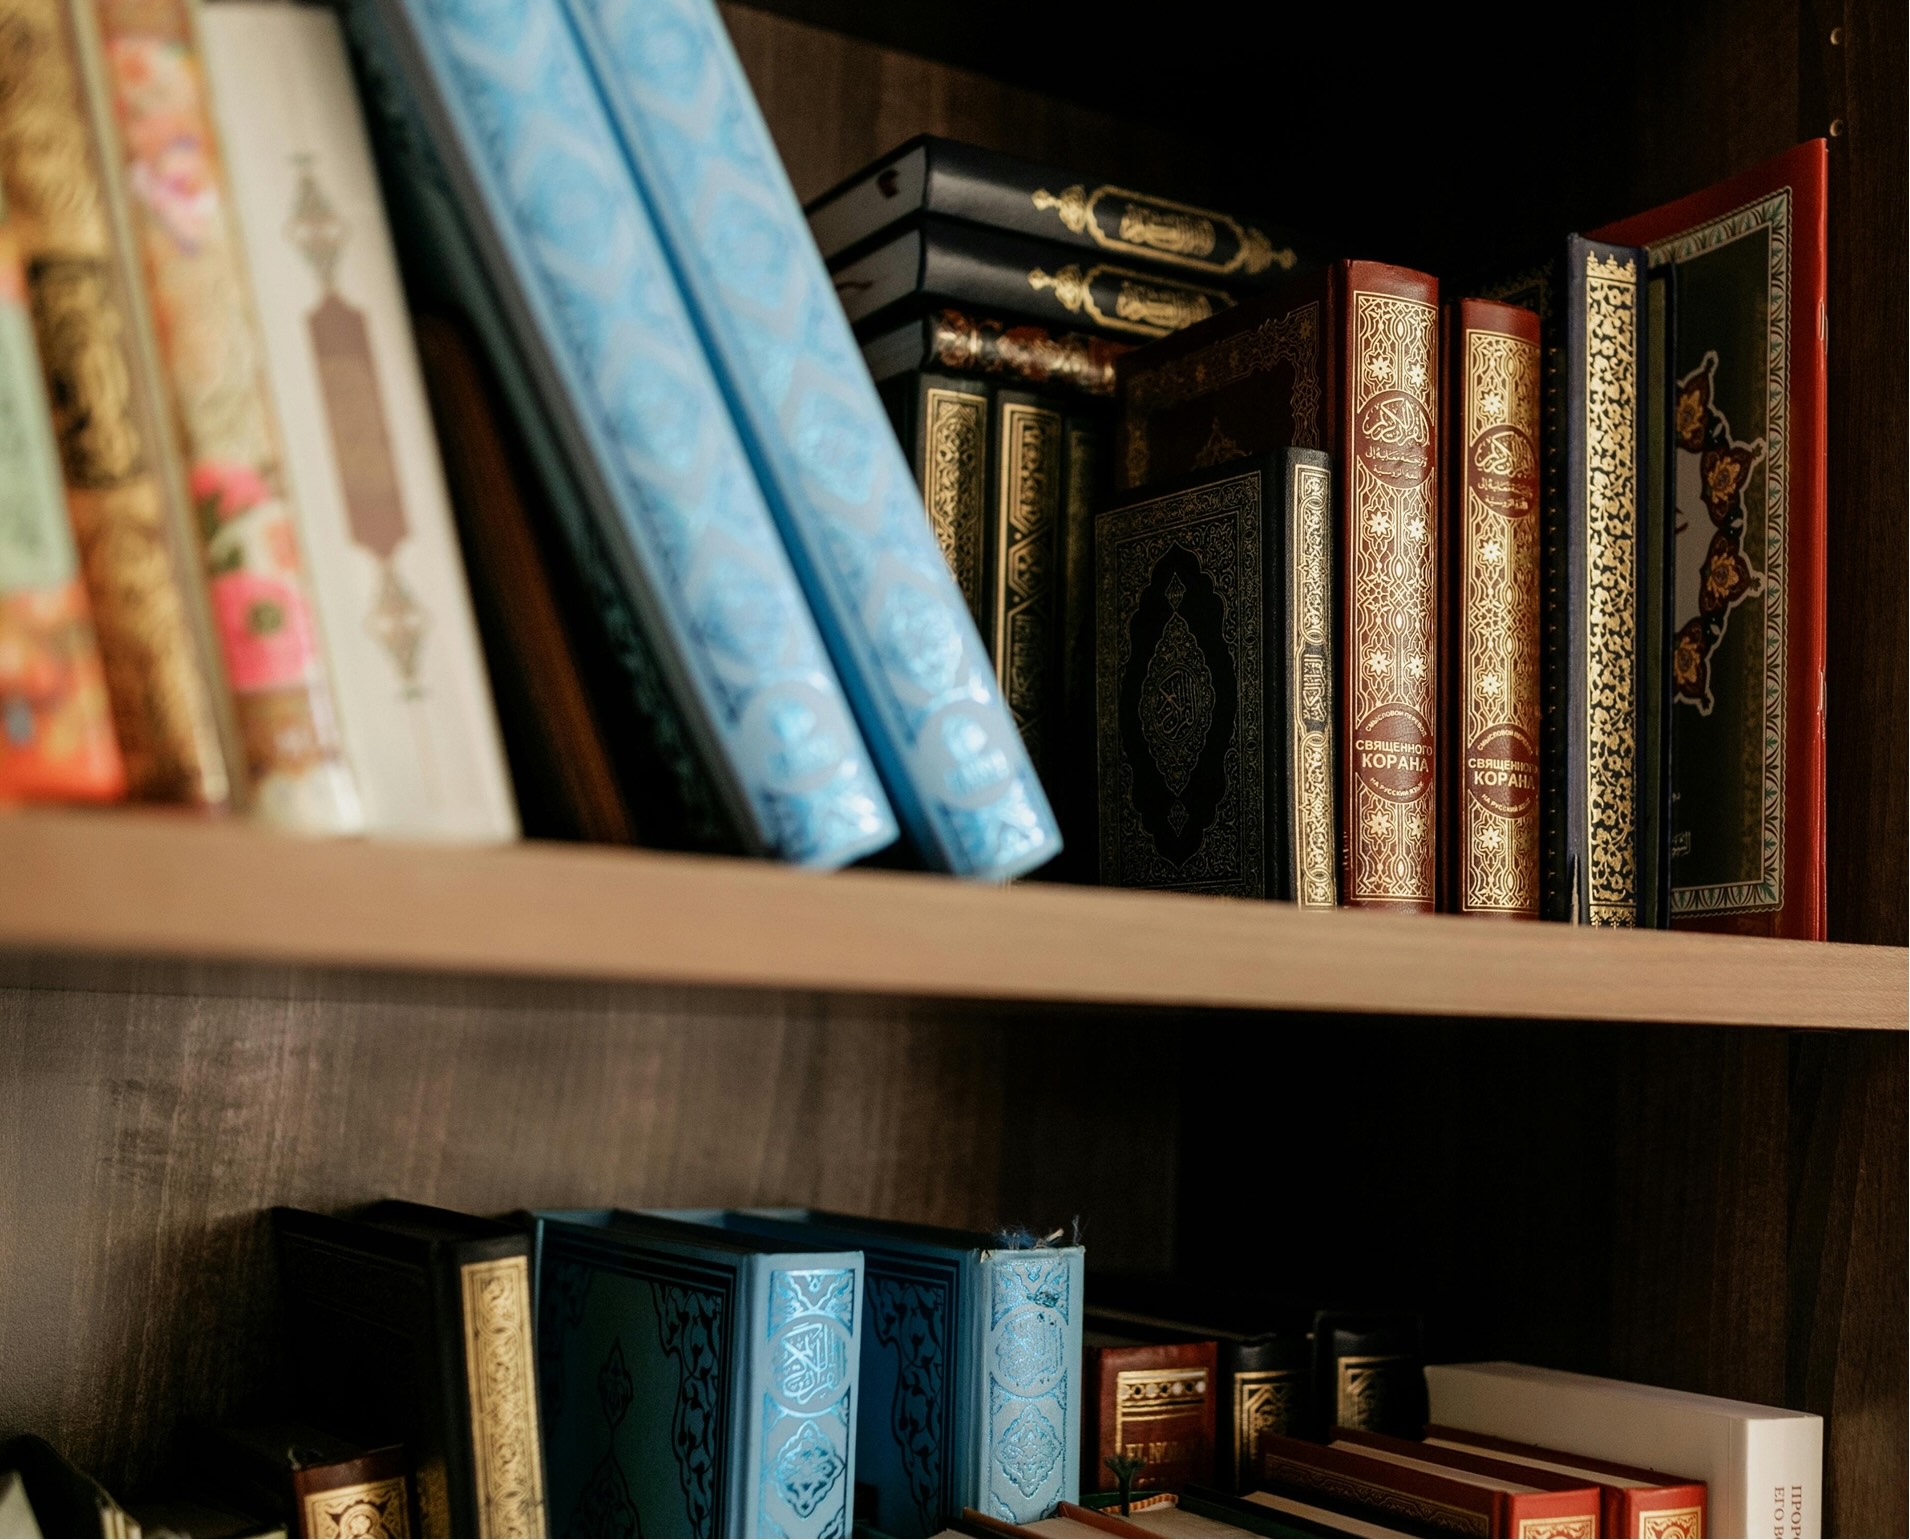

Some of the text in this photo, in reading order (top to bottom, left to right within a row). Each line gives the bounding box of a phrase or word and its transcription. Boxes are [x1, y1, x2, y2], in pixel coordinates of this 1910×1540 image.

[1404, 712, 1427, 737] ПЕРЕВОД
[1355, 740, 1433, 756] СВЯЩЕННОГО
[1362, 753, 1429, 773] КОРАНА
[1370, 777, 1380, 787] НА
[1474, 770, 1535, 790] КОРАНА
[1481, 794, 1491, 804] НА
[1774, 1487, 1785, 1539] ЕГО В
[1791, 1486, 1802, 1539] ПРОР
